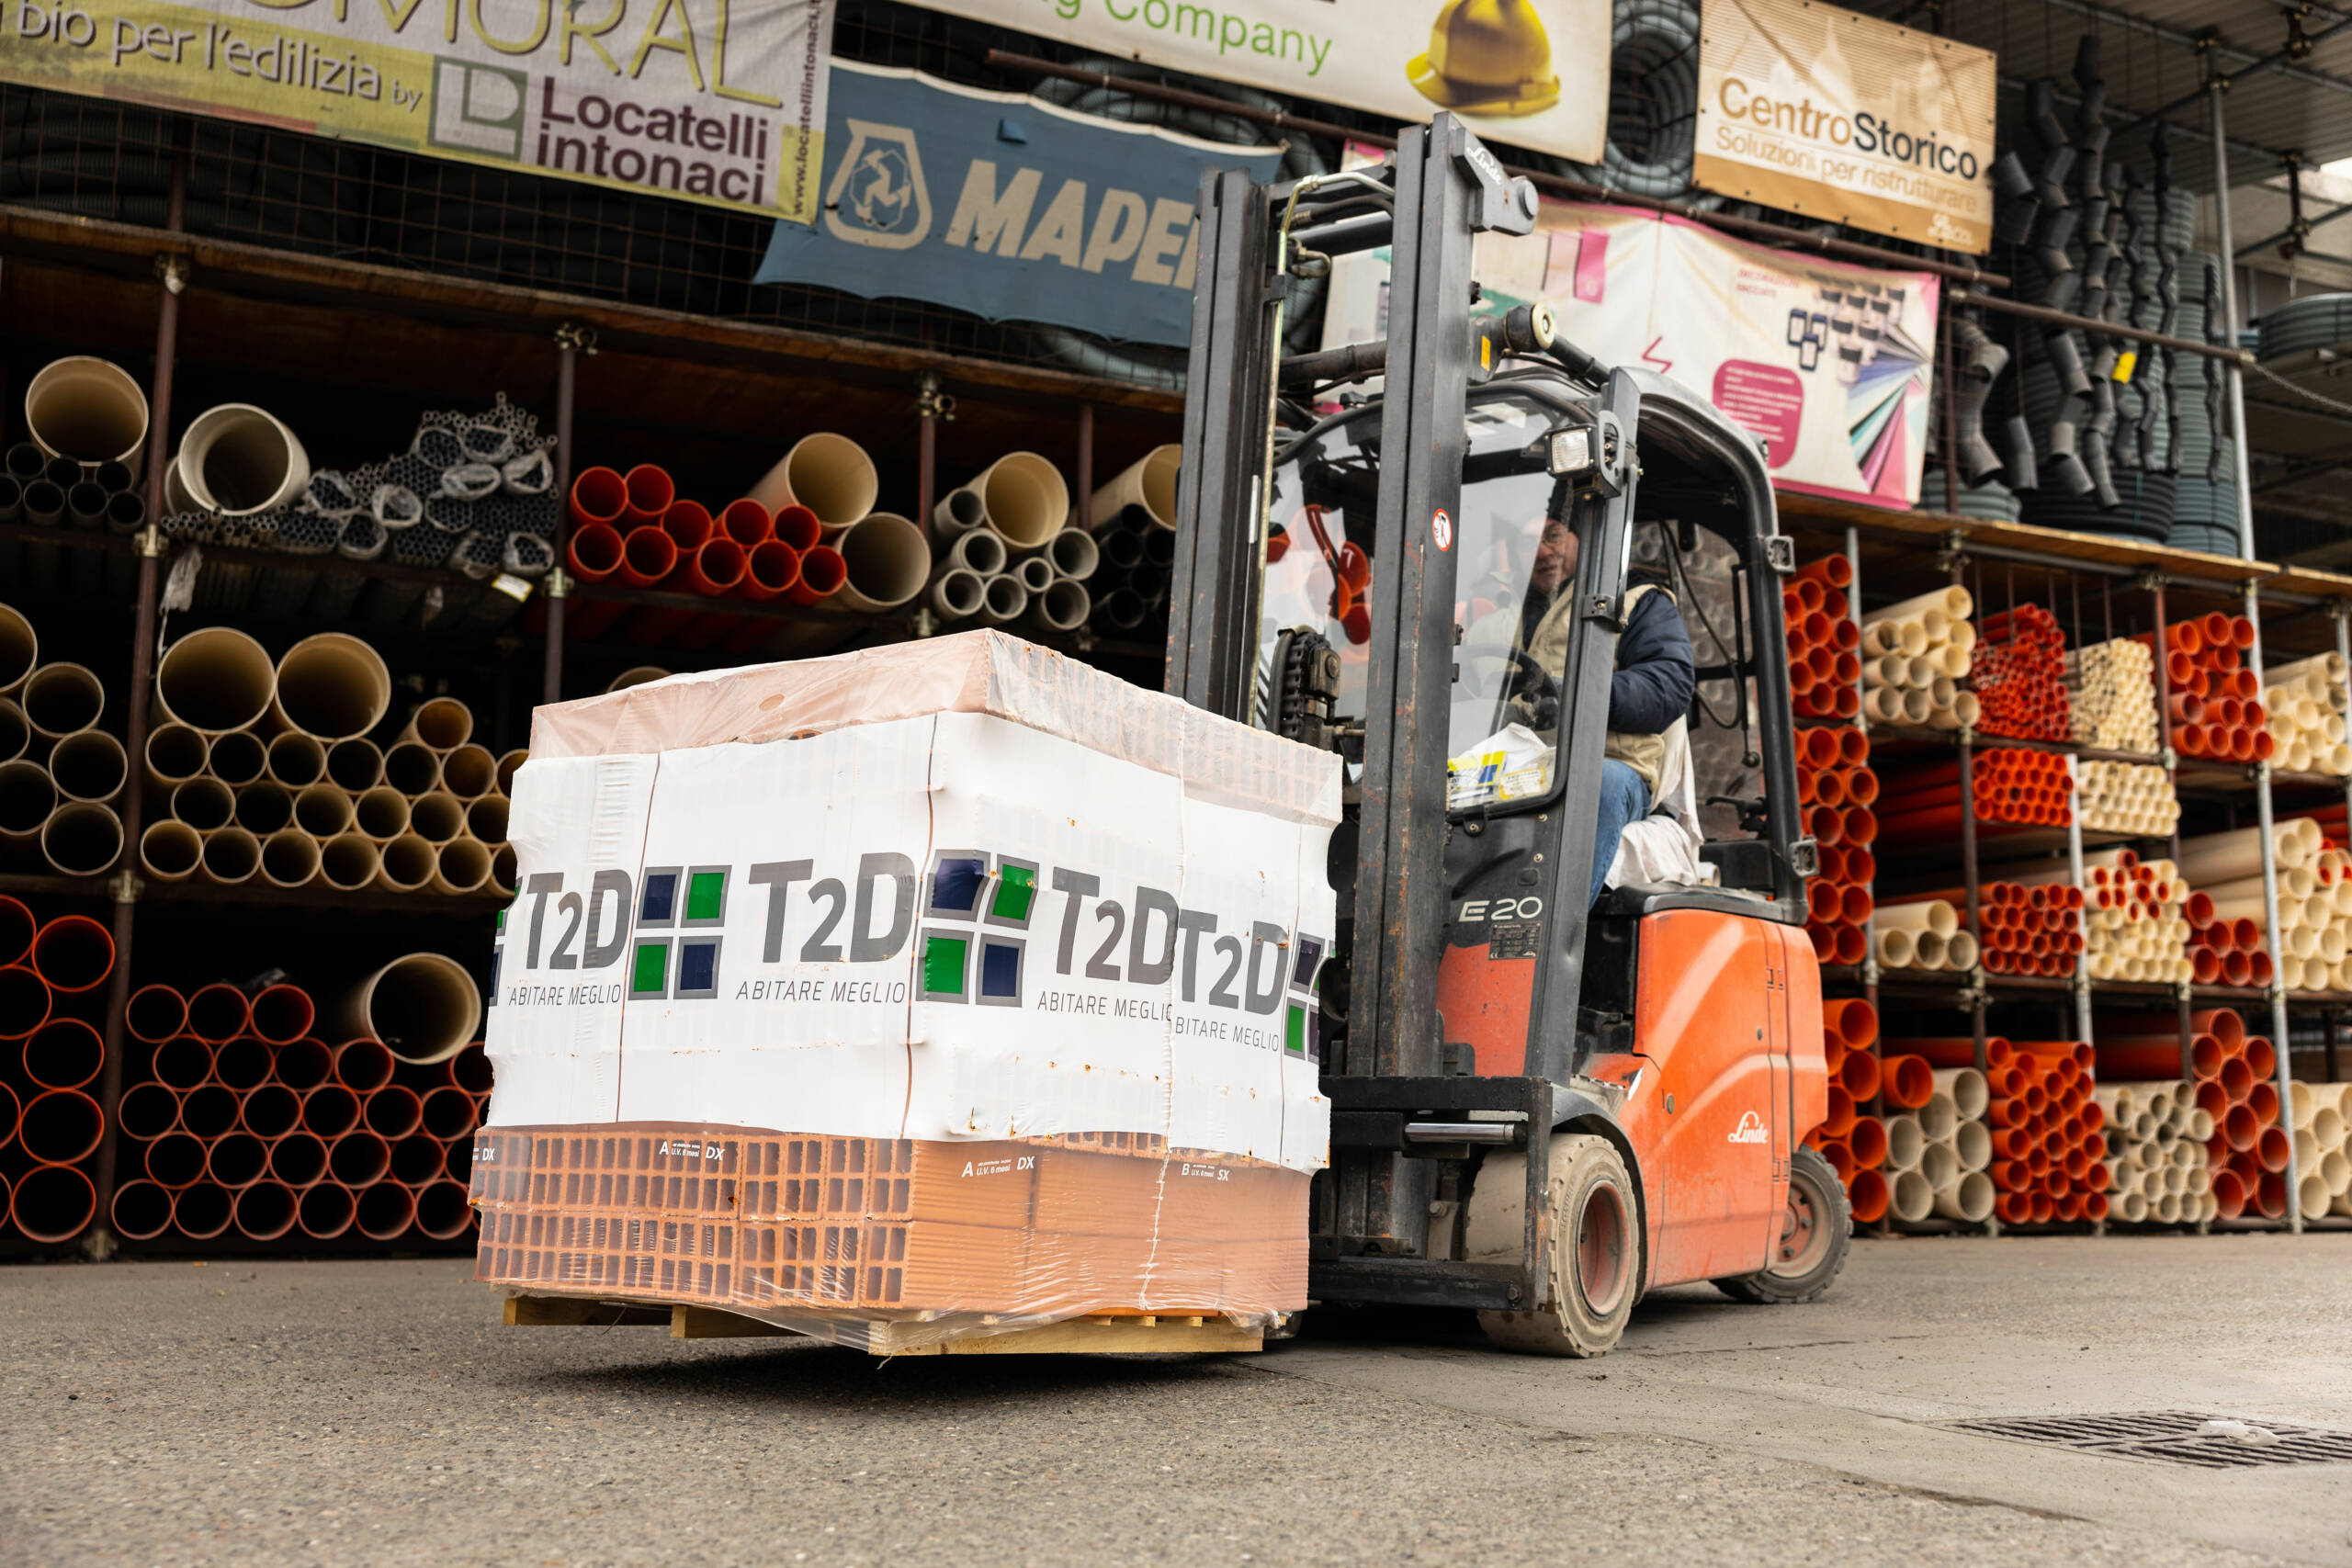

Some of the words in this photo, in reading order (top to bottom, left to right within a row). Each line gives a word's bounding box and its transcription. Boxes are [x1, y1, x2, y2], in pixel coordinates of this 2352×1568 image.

[110, 16, 197, 67] per
[391, 79, 423, 114] by
[541, 76, 769, 161] Locatelli
[1719, 77, 1977, 180] CentroStorico
[537, 122, 765, 206] intonaci
[1716, 126, 1816, 171] Soluzioni
[1820, 158, 1861, 181] per
[1862, 164, 1977, 214] ristrutturare
[526, 869, 632, 969] T2D
[748, 852, 916, 964] T2D
[1052, 866, 1179, 985] T2D
[1179, 908, 1289, 1016] T2D
[508, 985, 563, 1006] ABITARE
[569, 984, 621, 1006] MEGLIO
[736, 980, 824, 1001] ABITARE
[831, 981, 906, 1004] MEGLIO
[1037, 991, 1107, 1015] ABITARE
[1232, 1025, 1280, 1052] MEGLIO
[481, 1147, 495, 1161] DX
[659, 1141, 669, 1156] A
[705, 1146, 725, 1161] DX
[1728, 1111, 1768, 1145] Linde
[961, 1161, 974, 1178] A
[1016, 1156, 1035, 1170] DX
[1182, 1163, 1190, 1176] B
[1216, 1168, 1230, 1181] SX
